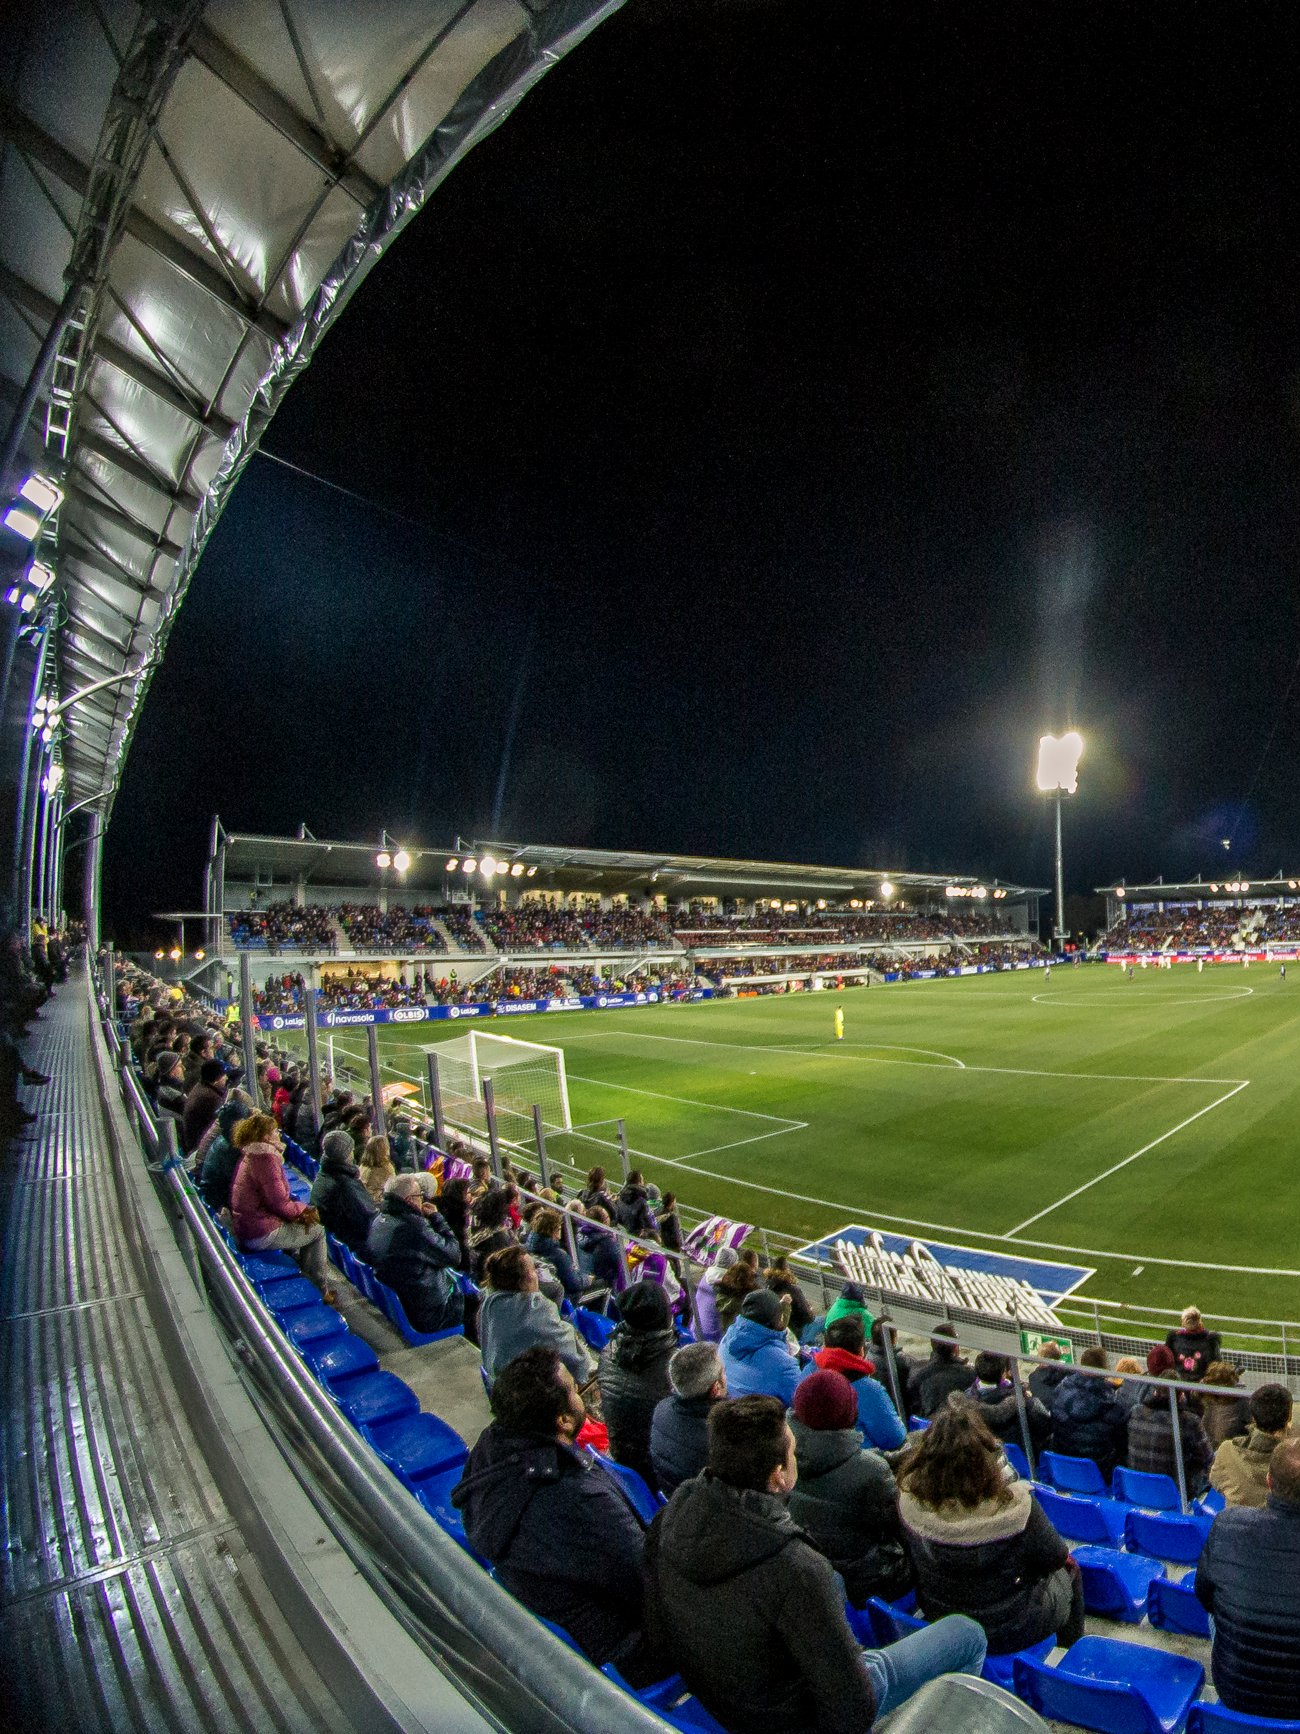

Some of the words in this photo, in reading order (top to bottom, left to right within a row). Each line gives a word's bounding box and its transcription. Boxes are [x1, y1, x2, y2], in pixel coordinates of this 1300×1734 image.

[460, 1007, 480, 1015] LaLiga
[505, 1002, 537, 1012] DISASEM
[335, 1014, 375, 1024] navasola
[397, 1011, 423, 1020] OLBIS
